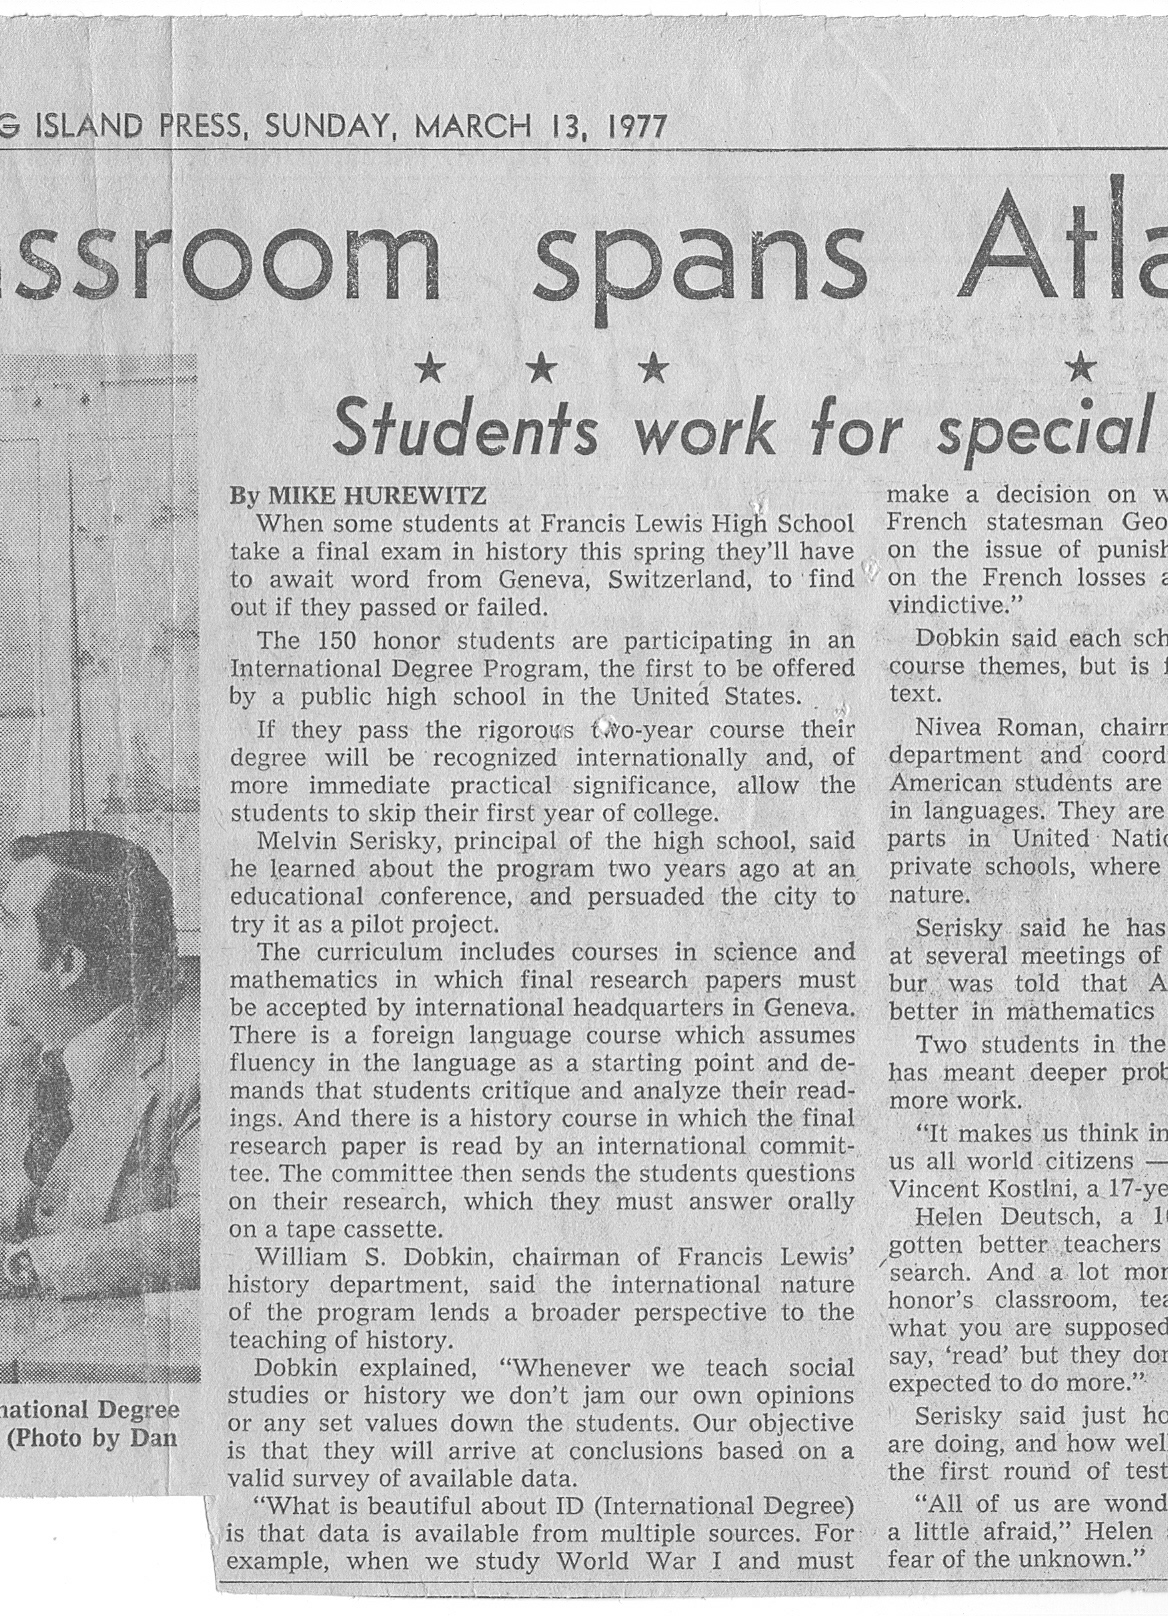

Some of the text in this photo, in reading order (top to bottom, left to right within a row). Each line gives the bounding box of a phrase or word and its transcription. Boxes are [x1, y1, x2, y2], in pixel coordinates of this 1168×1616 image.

[36, 112, 143, 139] ISLAND
[160, 112, 248, 141] PRESS,
[265, 112, 397, 142] SUNDAY,
[415, 113, 531, 139] MARCH
[553, 114, 587, 143] 13,
[609, 114, 668, 139] 1977
[532, 228, 868, 330] spans
[332, 391, 1156, 471] Students work for special
[230, 485, 487, 510] By MIKE HUREWITZ
[256, 513, 854, 537] When some students at Francis Lewis High School
[887, 511, 967, 531] French
[987, 513, 1103, 531] statesman
[231, 568, 855, 592] to await word from Geneva, Switzerland, to find
[256, 629, 855, 655] The 150 honor students are participating in an
[916, 627, 999, 647] Dobkin
[1012, 627, 1057, 648] said
[1069, 627, 1121, 648] each
[231, 657, 855, 682] International Degree Program, the first to be offered
[889, 772, 1162, 792] American students are
[890, 800, 1164, 825] in languages. They are
[257, 830, 855, 855] Melvin Serisky, principal of the high school, said
[890, 855, 1161, 880] private schools, where
[229, 1024, 855, 1049] There is a foreign language course which assumes
[915, 1033, 1166, 1054] Two students in the
[228, 1190, 855, 1216] on their research, which they must answer orally
[888, 1233, 1161, 1259] gotten better teachers
[228, 1274, 854, 1298] history department, said the international nature
[98, 1400, 180, 1424] Degree
[915, 1405, 1002, 1430] Serisky
[1020, 1405, 1065, 1425] said
[1084, 1405, 1125, 1427] just
[7, 1427, 82, 1451] (Photo
[93, 1427, 120, 1452] by
[130, 1428, 178, 1448] Dan
[226, 1550, 854, 1575] example, when we study World War I and must
